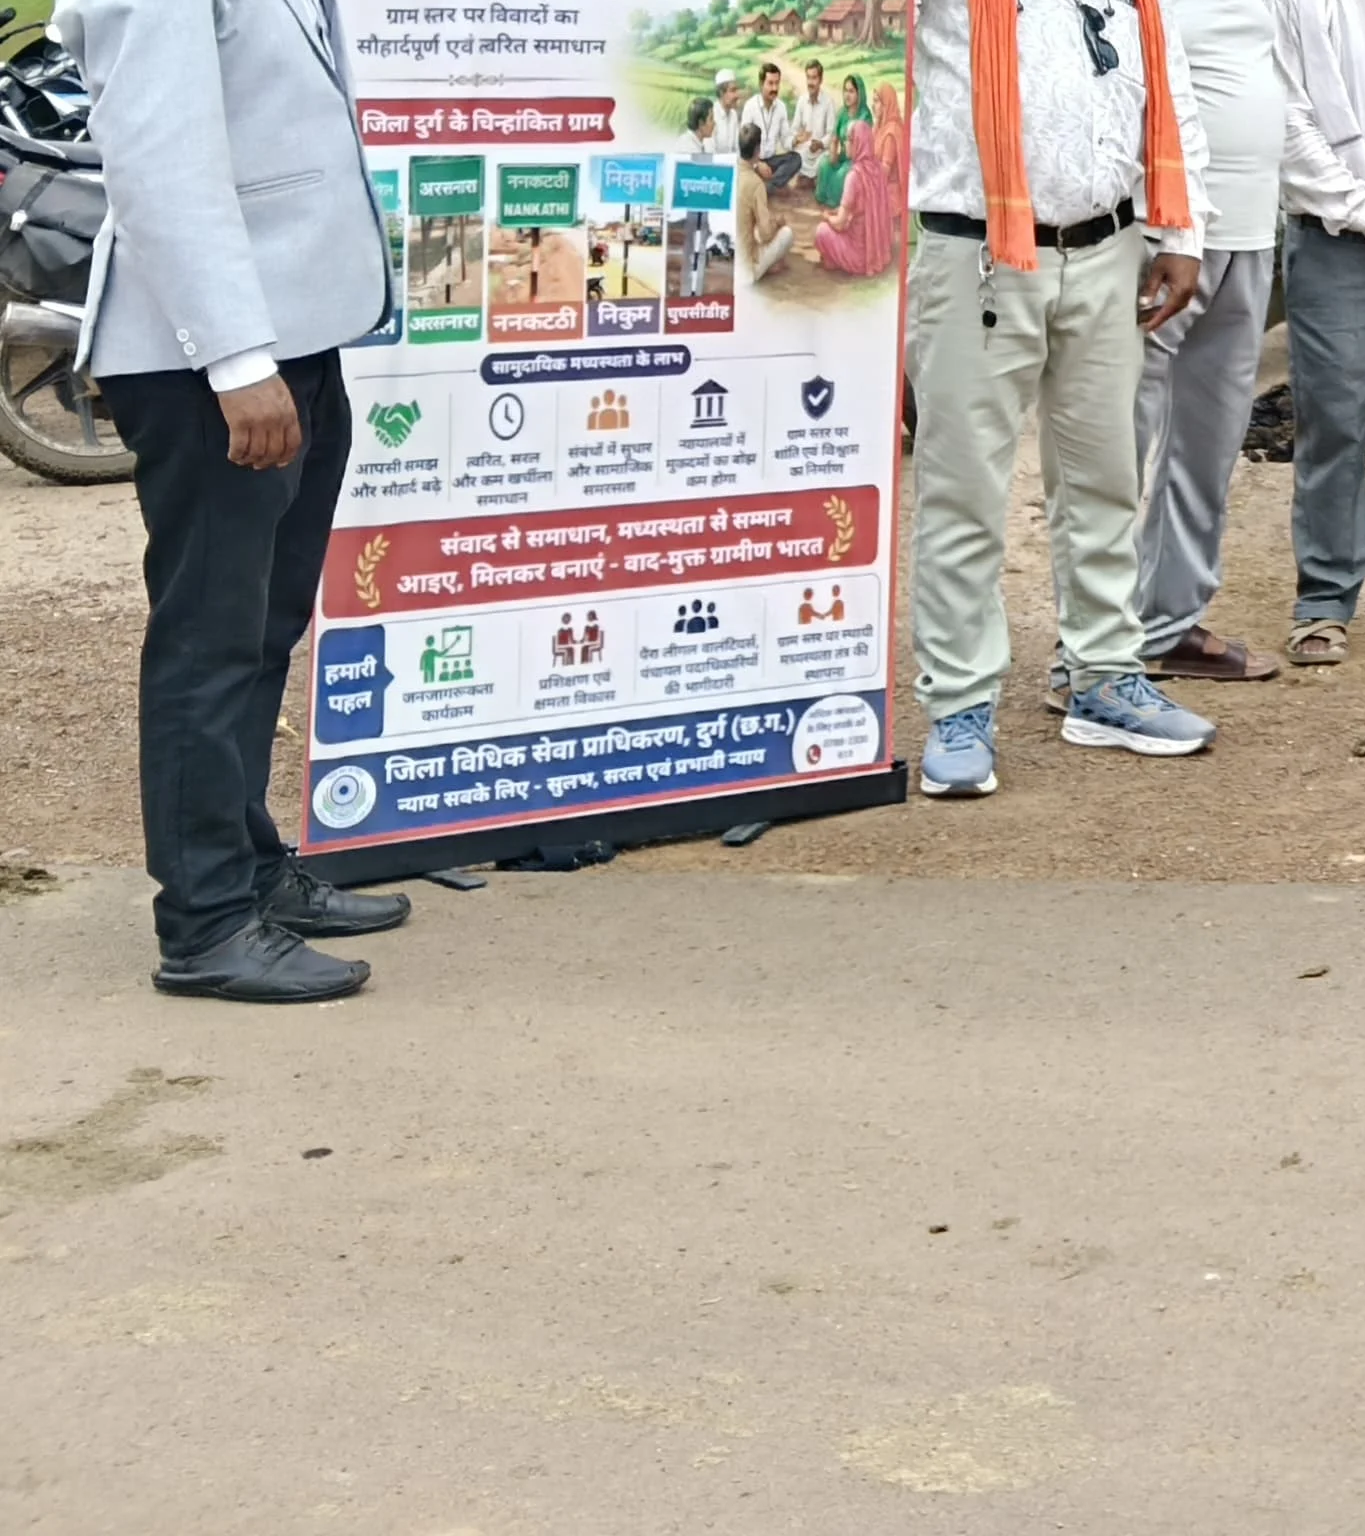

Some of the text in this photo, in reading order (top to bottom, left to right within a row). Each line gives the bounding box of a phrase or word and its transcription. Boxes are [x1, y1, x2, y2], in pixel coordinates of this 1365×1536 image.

[386, 3, 579, 24] ग्राम स्तर पर विवादों का
[357, 33, 606, 60] सौहार्दपूर्ण एवं त्वरित समाधान
[362, 108, 604, 138] जिला दुर्ग के चिन्हांकित ग्राम
[504, 202, 569, 216] NANKATHI
[598, 301, 653, 329] निकुम
[440, 509, 792, 555] संवाद से समाधान, मध्यस्थता से सम्मान
[397, 537, 824, 594] आइए, मिलकर बनाएं वाद-मुक्त ग्रामीण भारत
[325, 654, 377, 685] हमारी
[328, 691, 372, 714] पहल
[385, 755, 446, 784] जिला
[451, 744, 527, 774] विधिक
[532, 736, 577, 762] सेवा
[582, 726, 690, 756] प्राधिकरण,
[696, 714, 727, 748] दुर्ग
[732, 709, 794, 741] (छ.ग.)
[397, 749, 766, 812] न्याय सबके लिए सुलभ, सरल एवं प्रभावी न्याय
